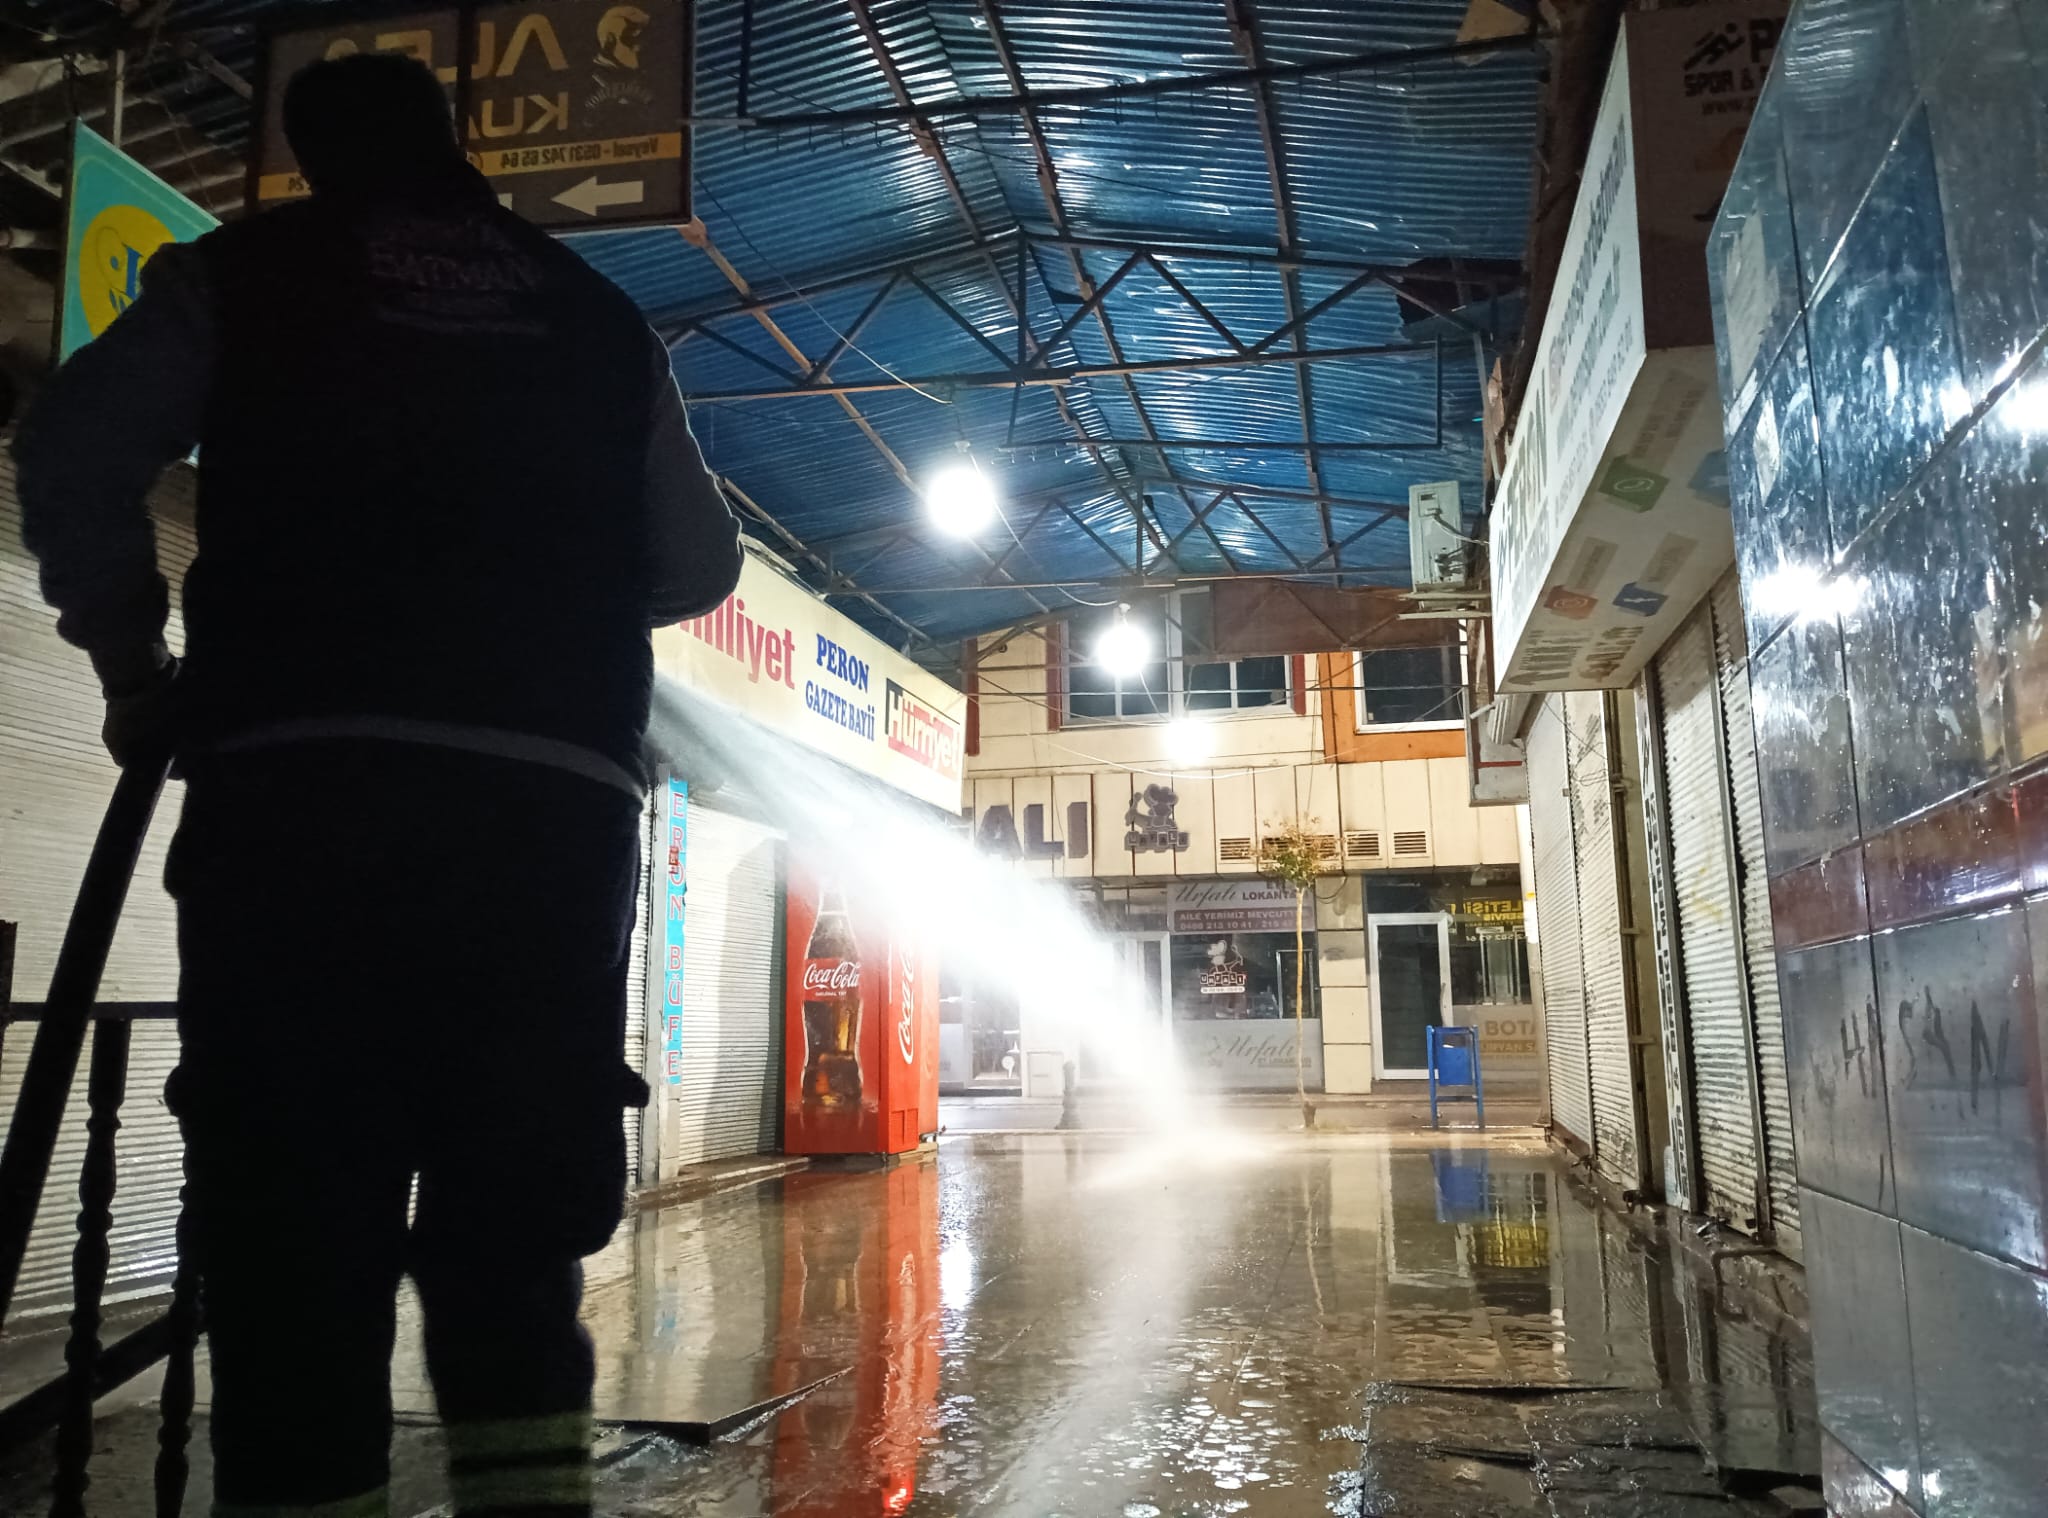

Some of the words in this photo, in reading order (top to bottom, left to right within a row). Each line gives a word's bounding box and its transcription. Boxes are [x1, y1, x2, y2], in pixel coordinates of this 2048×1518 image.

[816, 632, 870, 694] PERON
[805, 680, 848, 728] GAZETE
[888, 686, 960, 778] Hürriyet
[668, 780, 686, 922] ERON
[666, 945, 682, 1077] BÜFE
[803, 961, 862, 990] Coca-Cola
[1200, 972, 1246, 986] URFALI
[1675, 1105, 1689, 1198] SPOR
